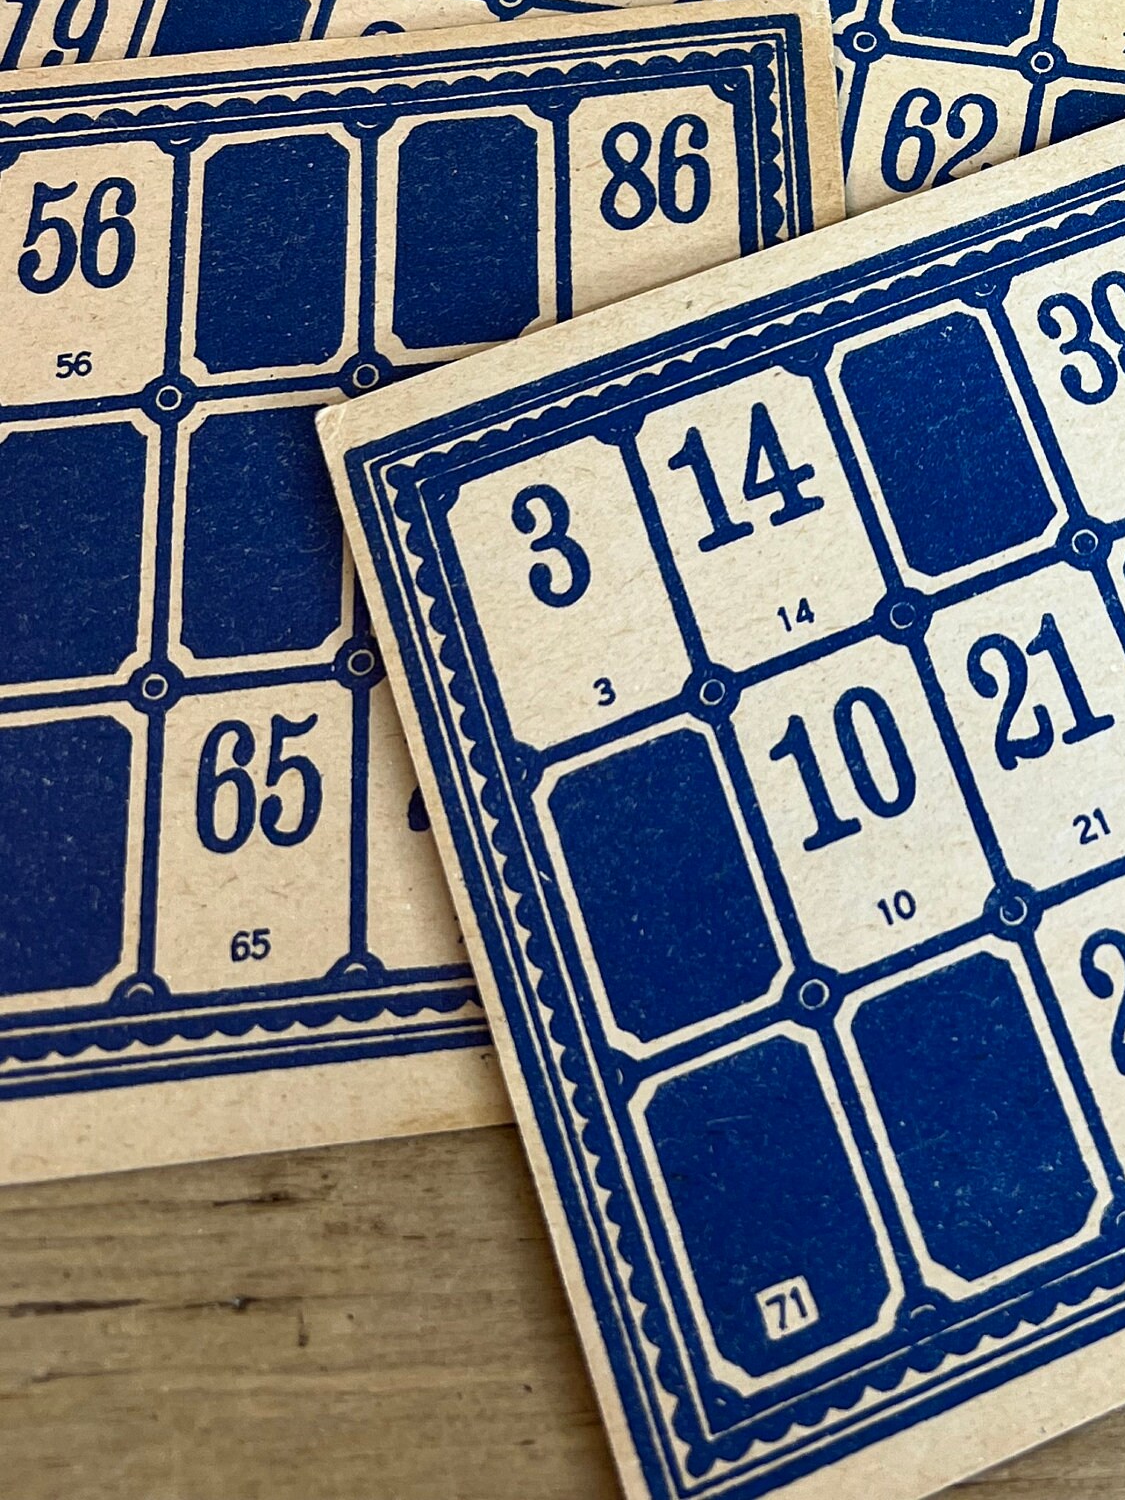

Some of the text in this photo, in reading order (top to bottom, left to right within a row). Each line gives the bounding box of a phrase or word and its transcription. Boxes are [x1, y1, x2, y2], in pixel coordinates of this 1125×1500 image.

[880, 87, 999, 192] 62
[18, 114, 711, 294] 56 86
[56, 351, 92, 378] 56
[511, 484, 591, 608] 3
[668, 402, 824, 552] 14
[594, 678, 616, 706] 3
[777, 598, 814, 632] 14
[196, 713, 322, 854] 65
[770, 687, 916, 851] 10
[967, 613, 1114, 770] 21
[877, 890, 916, 925] 10
[1073, 808, 1110, 844] 21
[231, 928, 271, 962] 65
[766, 1287, 807, 1330] 71
